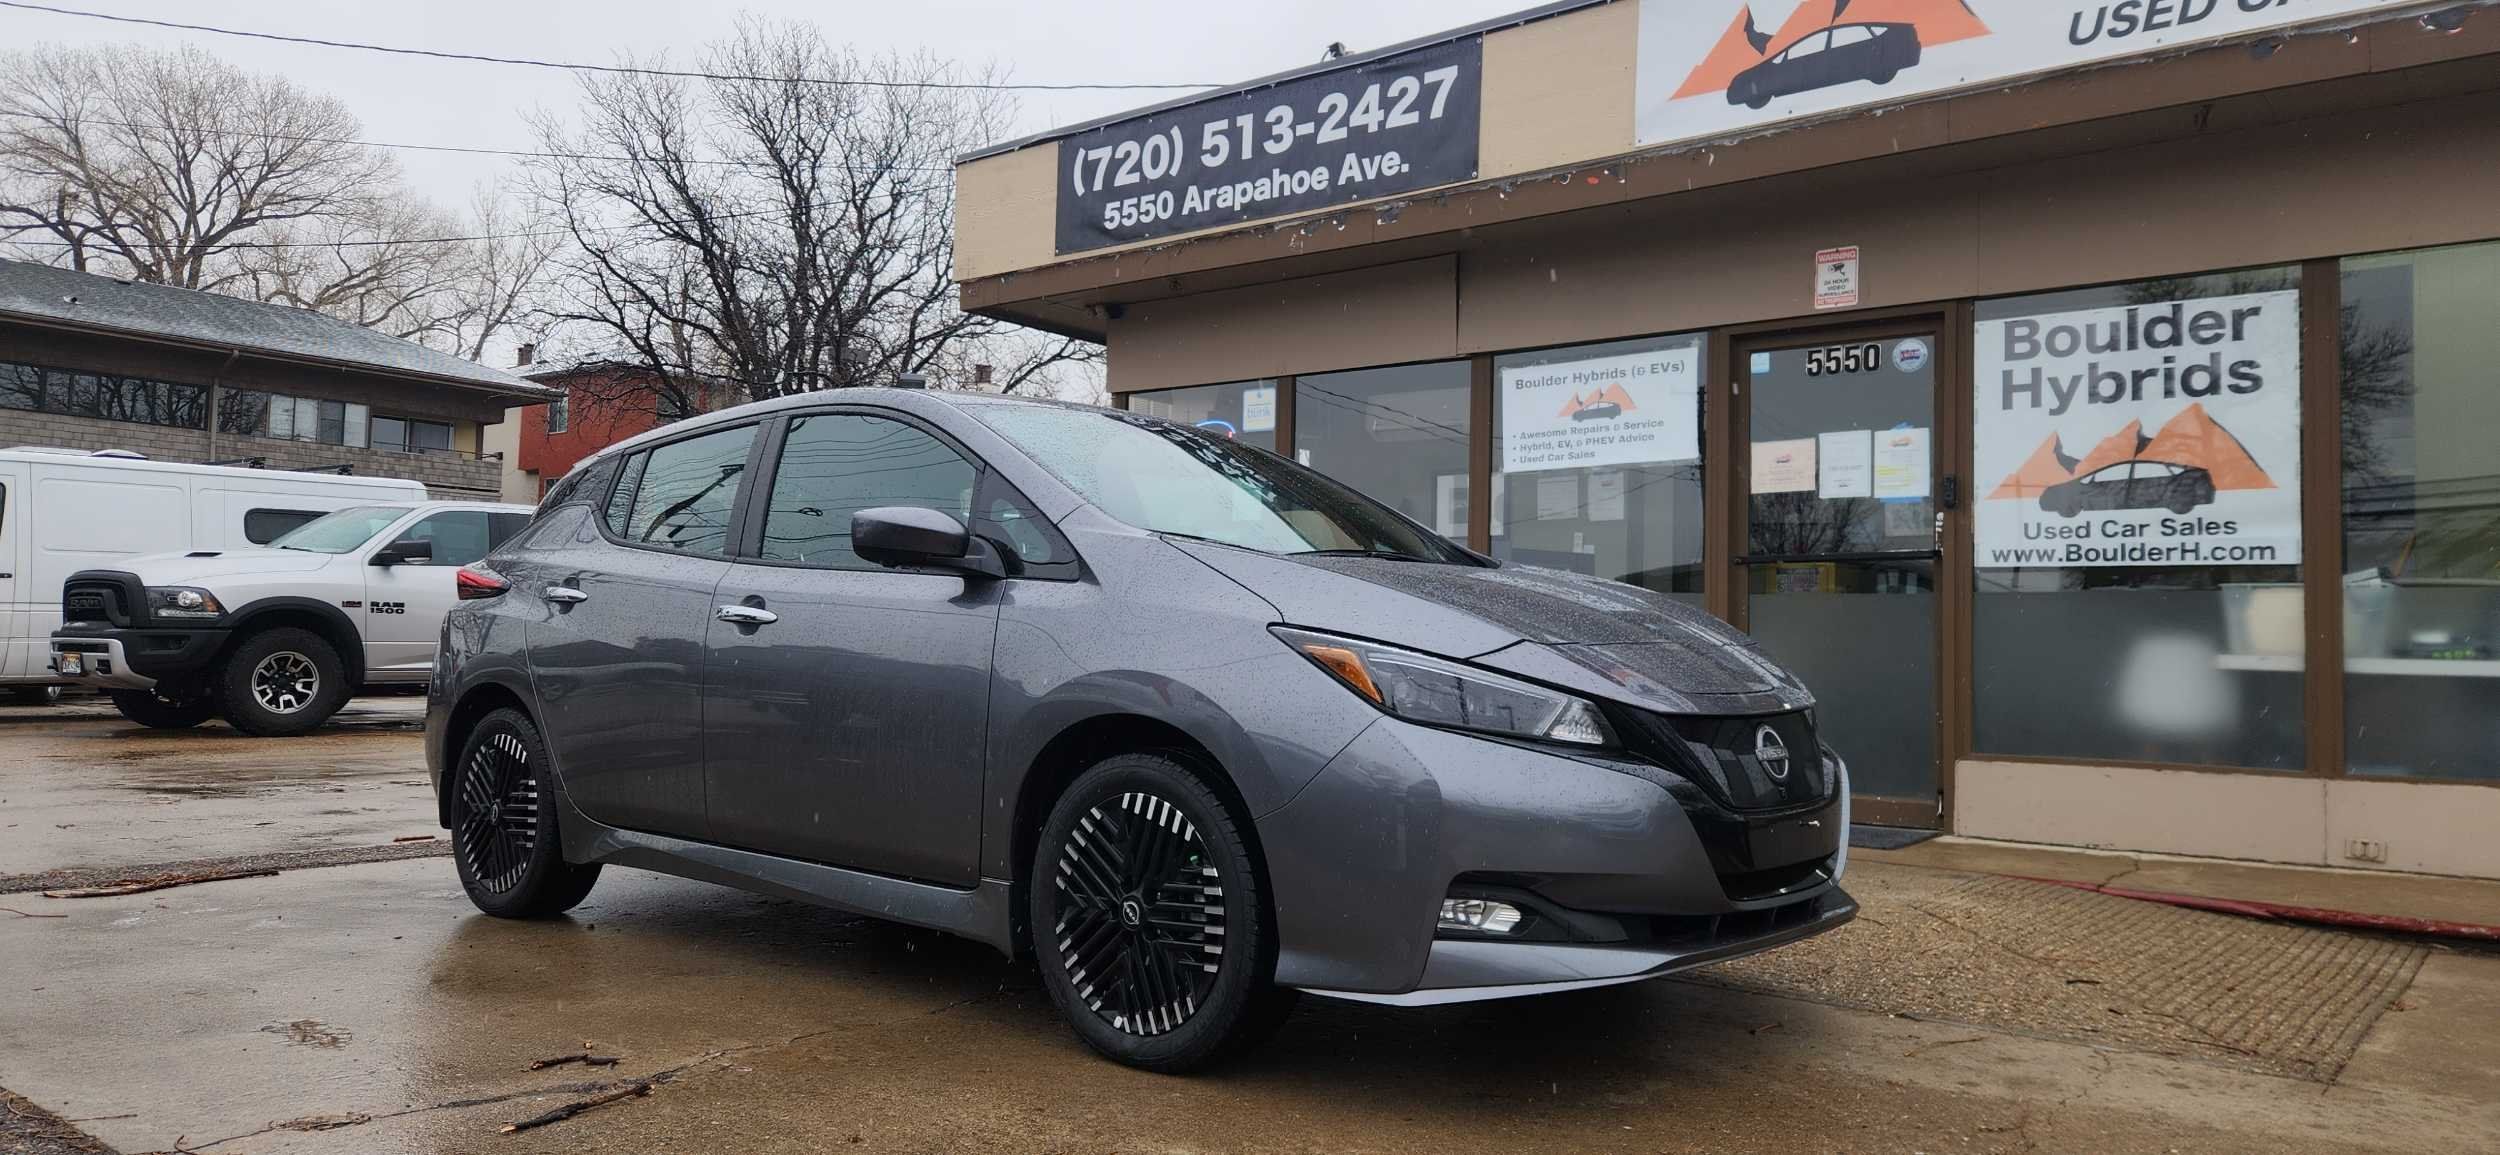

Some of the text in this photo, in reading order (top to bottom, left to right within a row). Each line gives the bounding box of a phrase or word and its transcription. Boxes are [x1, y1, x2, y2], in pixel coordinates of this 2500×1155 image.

[2068, 0, 2218, 45] USED
[1073, 64, 1459, 197] (720) 513-2427
[1103, 151, 1409, 230] 5550 Arapahoe Ave.
[2003, 303, 2262, 362] Boulder
[1515, 374, 1568, 390] Boulder
[1572, 367, 1627, 386] Hybrids
[1650, 359, 1685, 375] EVs)
[1806, 343, 1881, 377] 5550
[2001, 351, 2264, 416] Hybrids
[1519, 429, 1567, 440] Awesome
[1570, 423, 1610, 437] Repairs
[1623, 419, 1665, 431] Service
[1519, 441, 1554, 453] Hybrid,
[1557, 440, 1573, 449] EV,
[1585, 435, 1615, 446] PHEV
[1618, 431, 1655, 443] Advice
[1519, 450, 1596, 464] Used Car Sales
[2023, 516, 2238, 540] Used Car Sales
[1992, 542, 2277, 564] www.BoulderH.com
[370, 607, 405, 615] 1500
